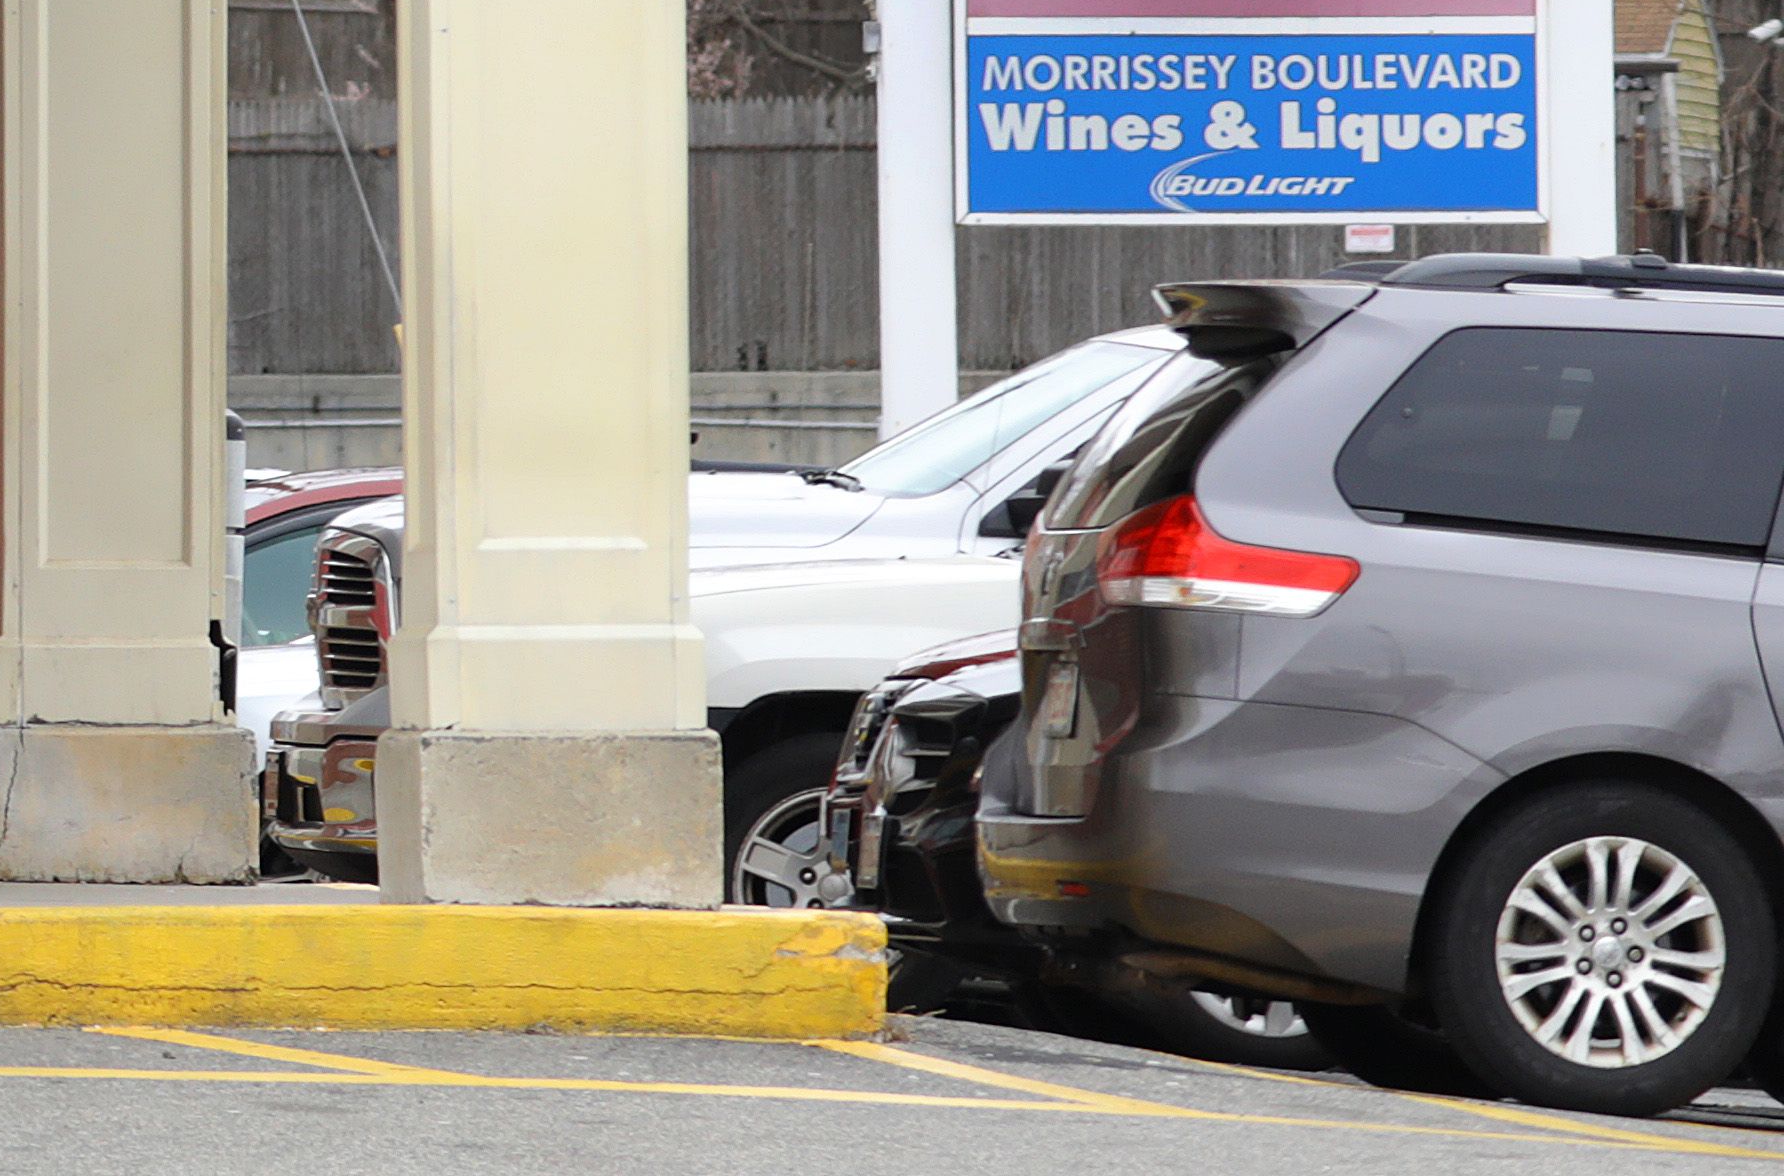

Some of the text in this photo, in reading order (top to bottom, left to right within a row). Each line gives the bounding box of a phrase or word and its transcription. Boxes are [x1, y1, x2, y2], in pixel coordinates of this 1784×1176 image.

[982, 53, 1522, 91] MORRISSEY BOULEVARD
[979, 97, 1528, 164] Wines & Liquors
